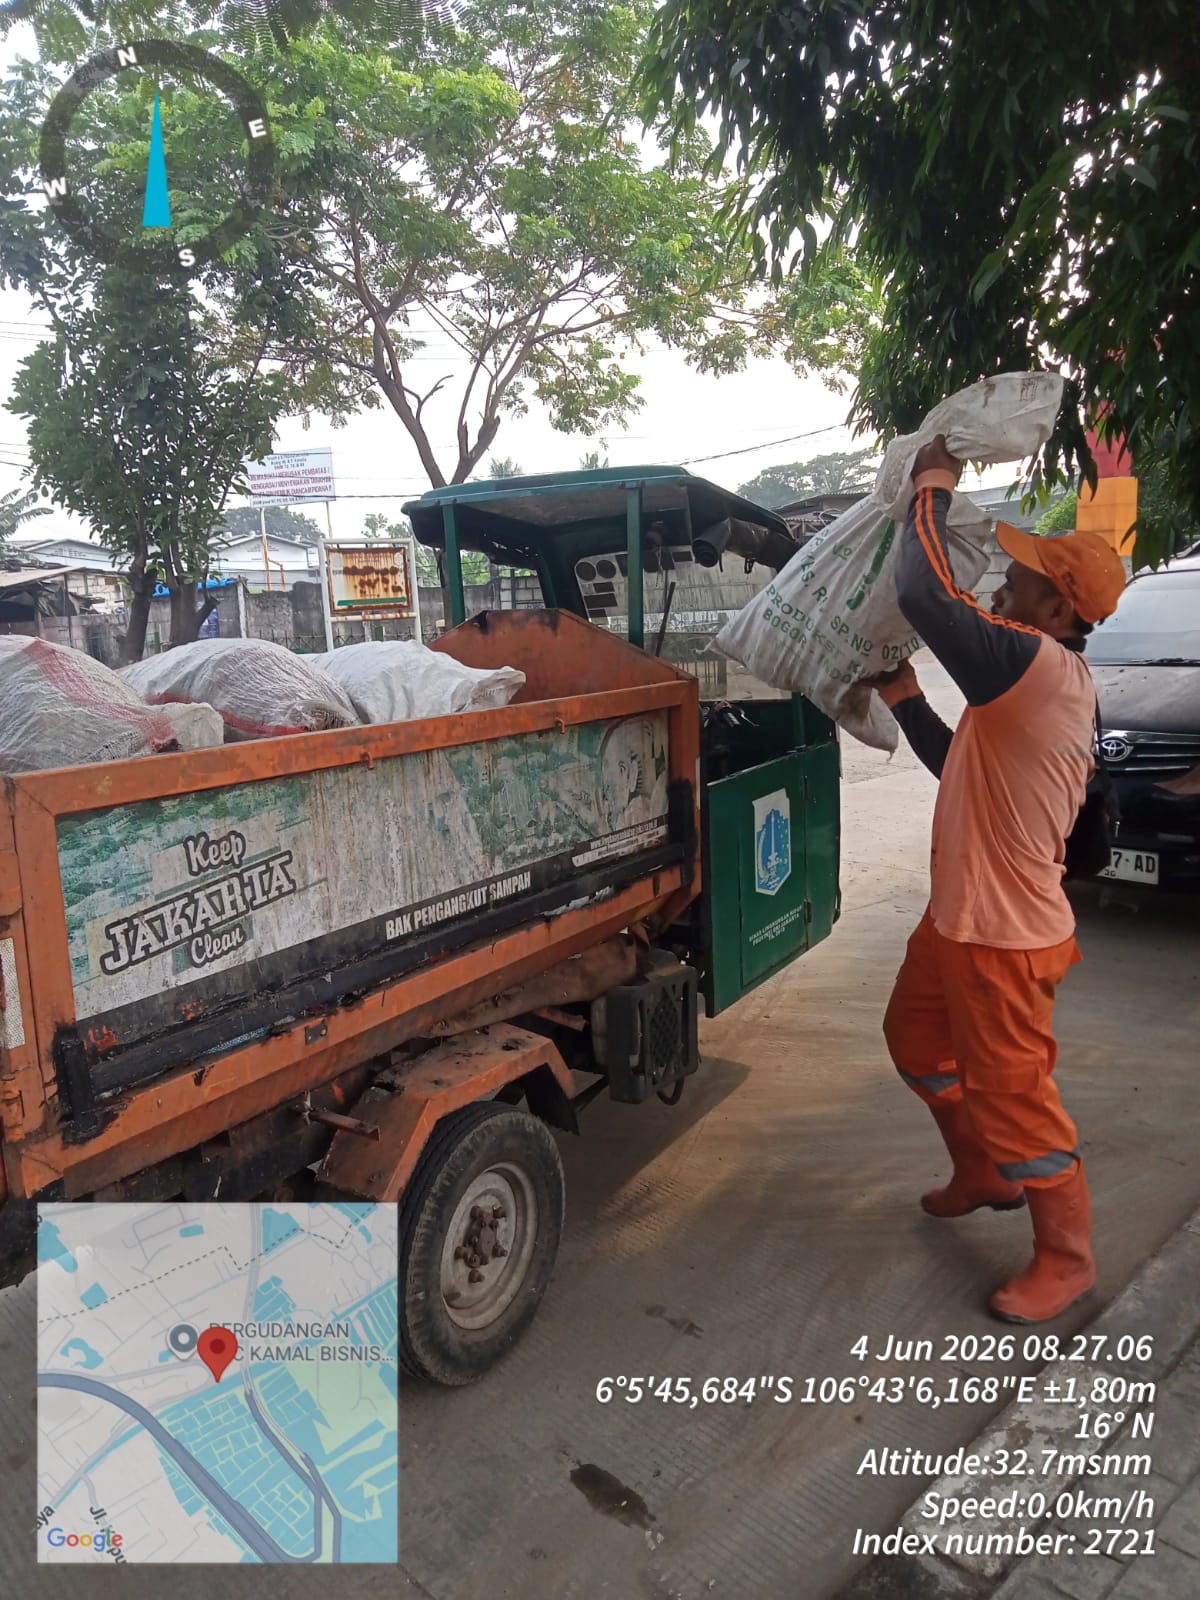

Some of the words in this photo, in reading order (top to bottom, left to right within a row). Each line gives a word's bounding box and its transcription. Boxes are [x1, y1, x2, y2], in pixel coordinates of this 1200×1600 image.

[763, 607, 807, 648] BOGOR
[185, 831, 245, 875] Keep
[1134, 854, 1156, 873] AD
[101, 852, 295, 974] JAKARTA
[385, 913, 413, 940] BAK
[413, 886, 488, 930] PENGANGKUT
[489, 871, 531, 900] SAMPAH
[189, 924, 245, 967] Clean
